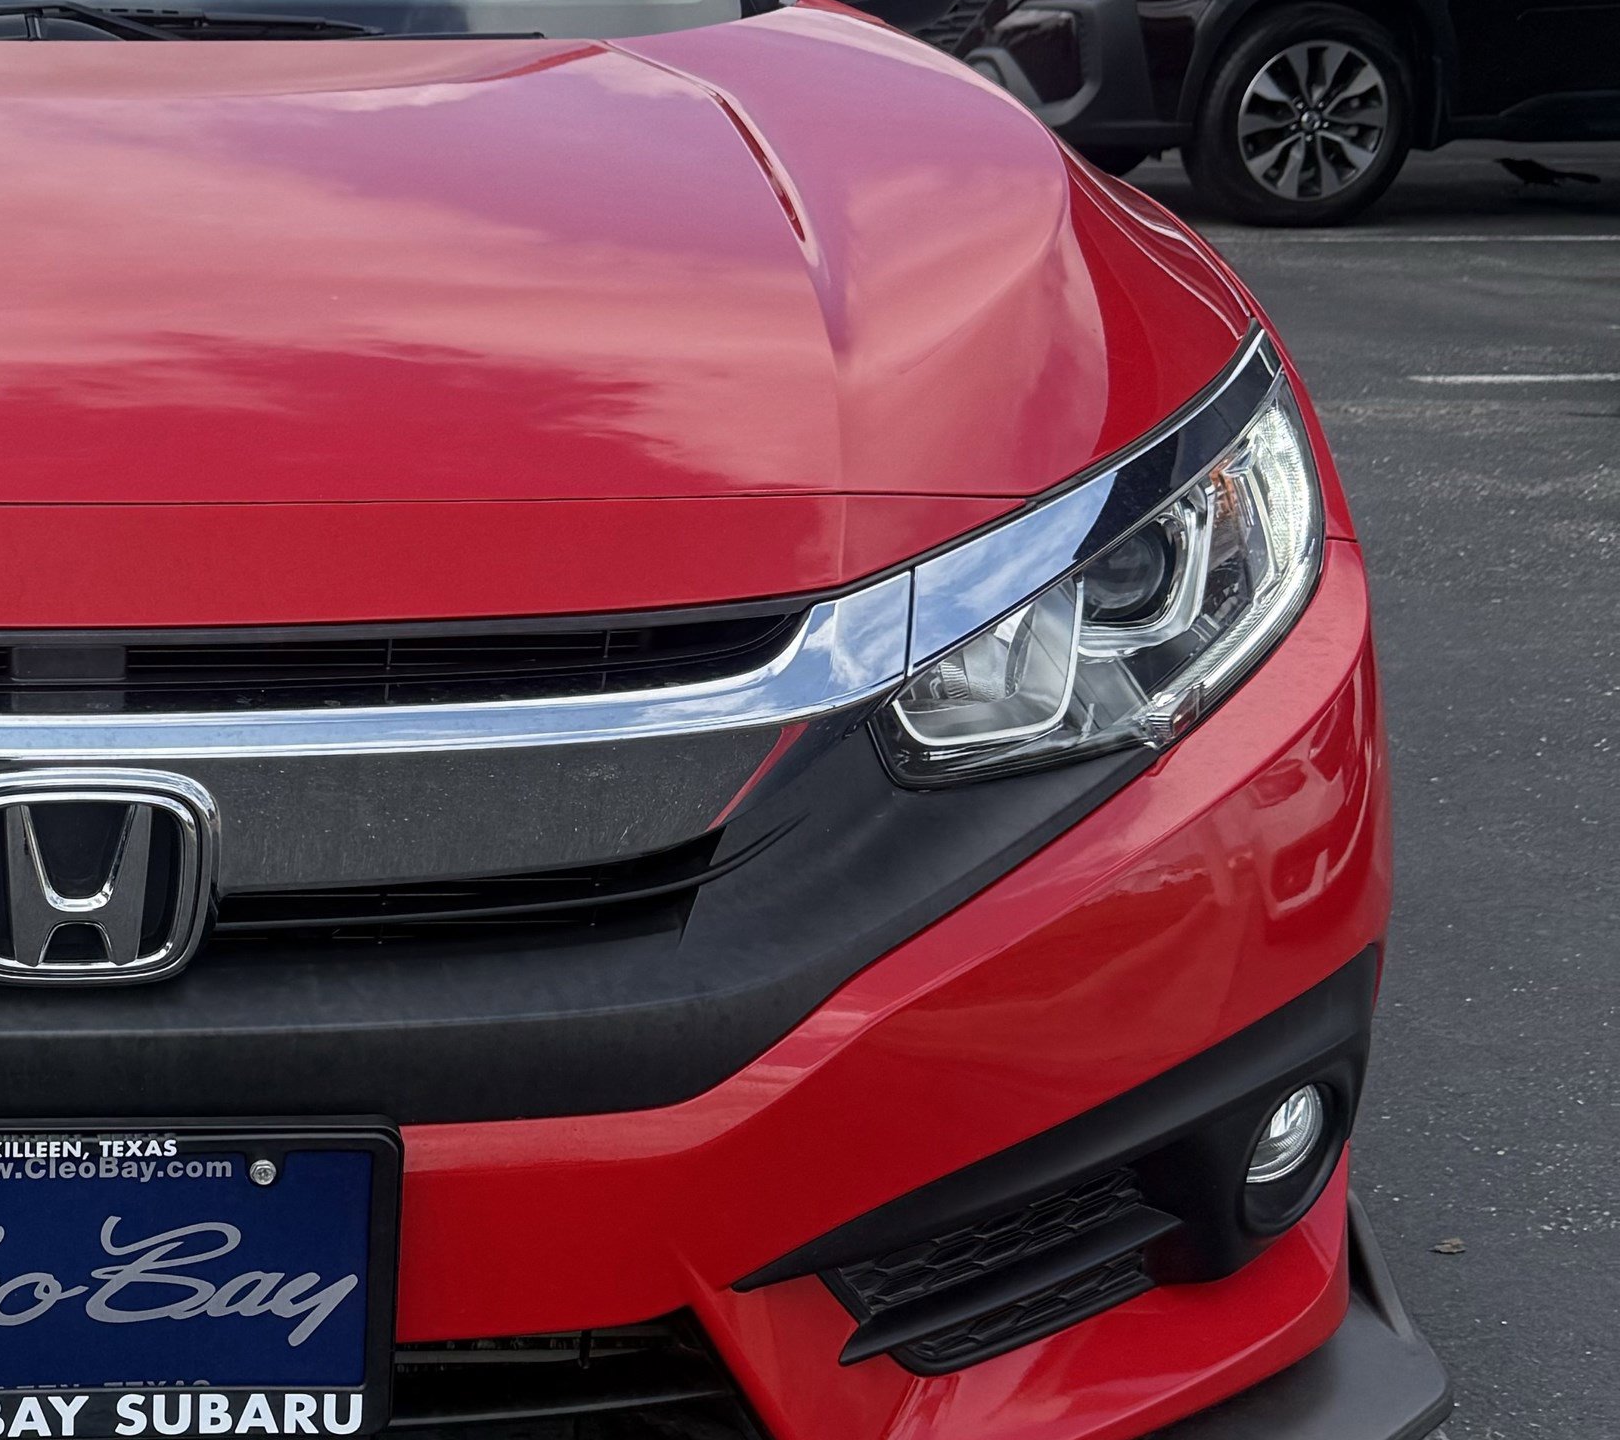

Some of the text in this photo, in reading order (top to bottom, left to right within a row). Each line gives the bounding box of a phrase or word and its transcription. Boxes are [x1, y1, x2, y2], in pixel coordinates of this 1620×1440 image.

[99, 1139, 178, 1158] TEXAS
[84, 1215, 359, 1347] Bay
[114, 1393, 363, 1436] SUBARU
